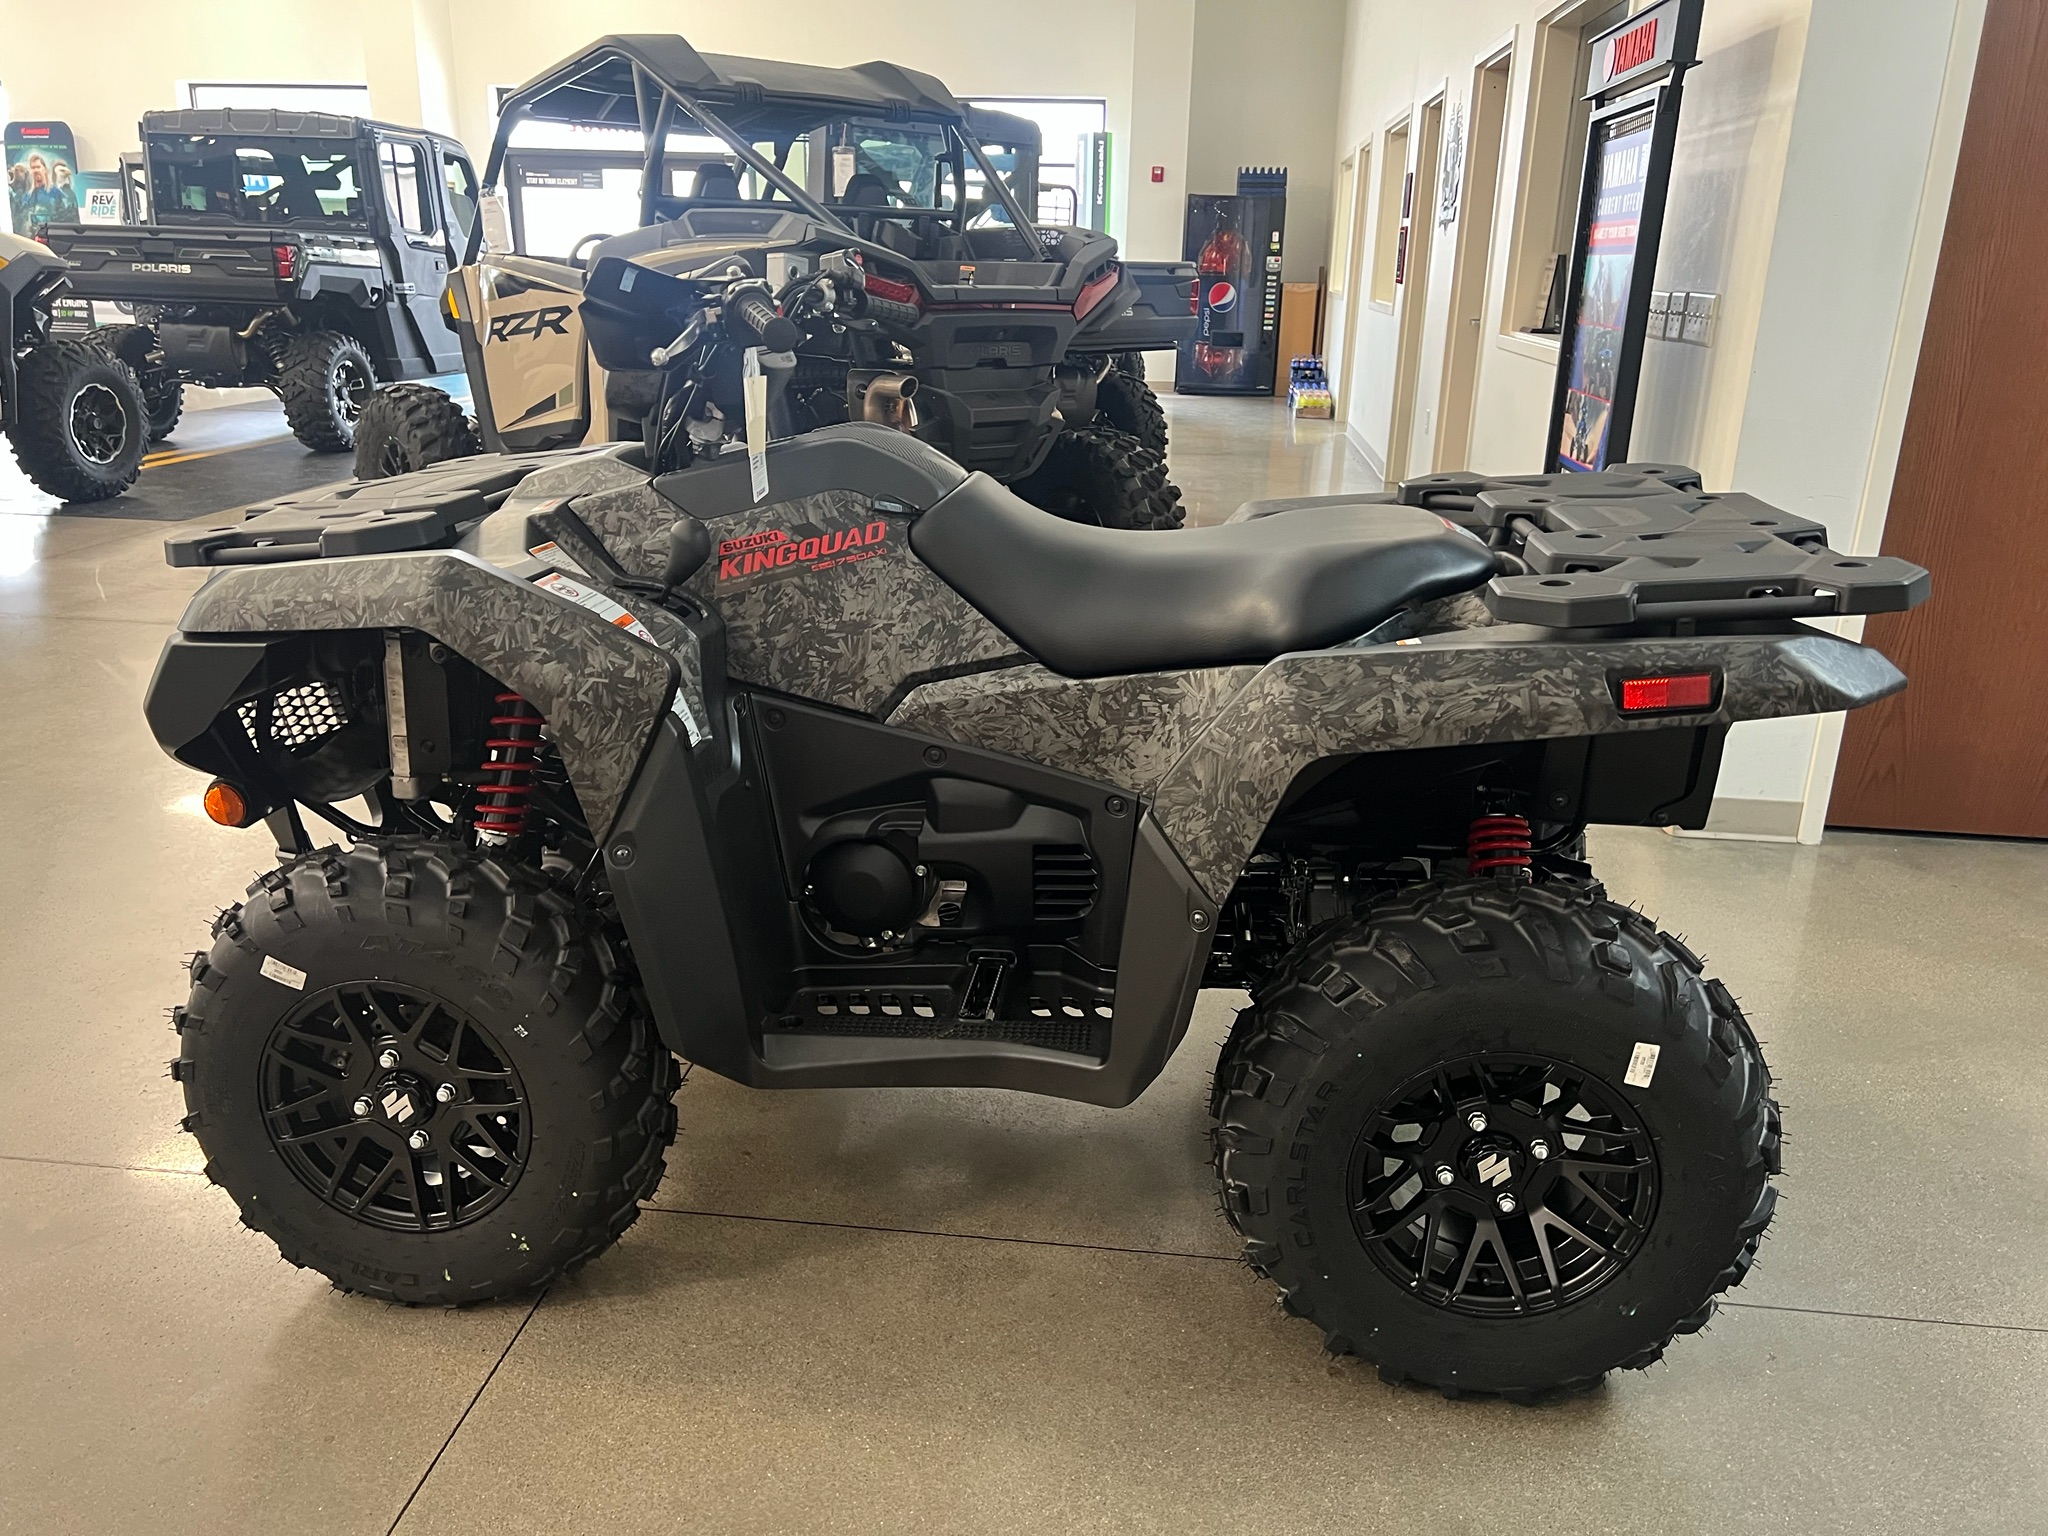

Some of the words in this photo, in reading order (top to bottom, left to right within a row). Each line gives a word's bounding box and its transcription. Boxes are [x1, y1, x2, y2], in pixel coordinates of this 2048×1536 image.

[1613, 17, 1658, 76] YAMAHA
[1096, 140, 1105, 205] Kawasaki
[1602, 145, 1640, 190] YAMAHA
[90, 205, 116, 217] RIDE
[91, 194, 114, 205] REV
[131, 262, 192, 274] POLARIS
[486, 305, 573, 347] RZR
[1203, 307, 1211, 337] pepsi
[720, 521, 887, 580] KINGQUAD
[722, 531, 780, 553] SUZUKI
[1286, 1079, 1343, 1249] CARLSTAR
